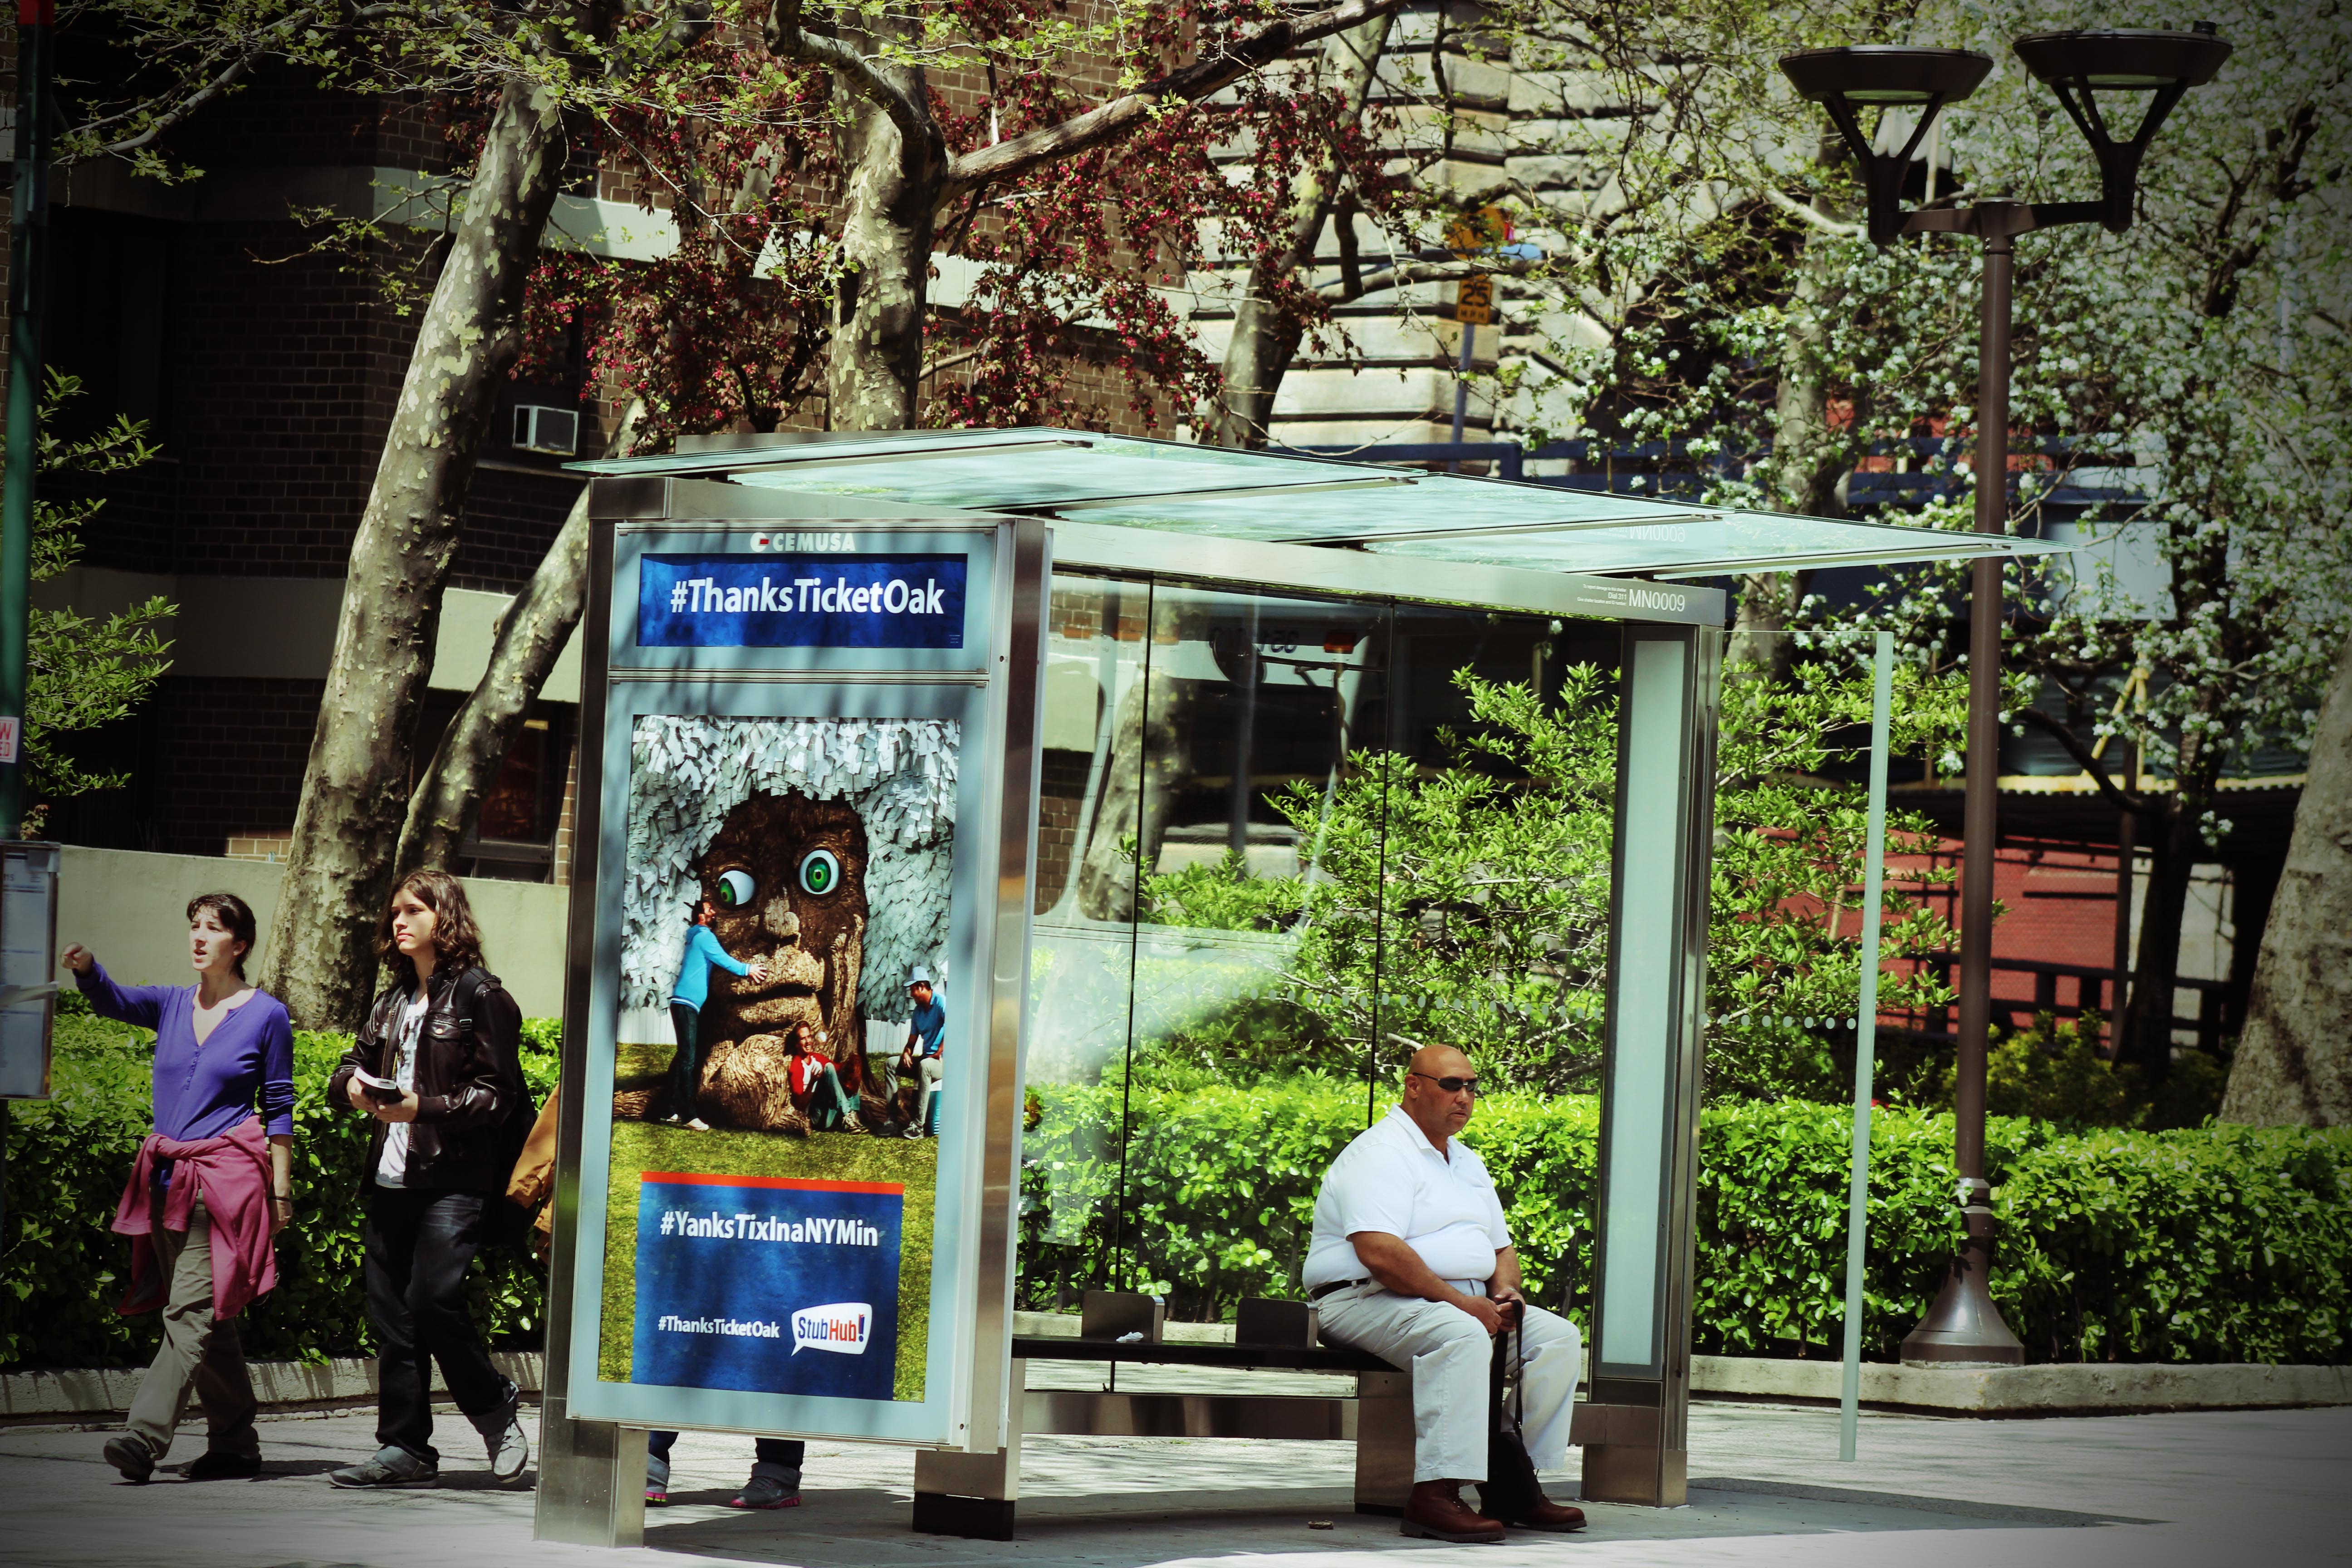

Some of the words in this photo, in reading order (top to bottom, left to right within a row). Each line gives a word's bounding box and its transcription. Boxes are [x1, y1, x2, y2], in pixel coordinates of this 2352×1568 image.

[1462, 284, 1488, 307] 25
[772, 532, 857, 552] CEMUSA
[671, 577, 945, 614] #ThanksTicketOak
[1629, 588, 1685, 612] MN0009
[660, 1210, 878, 1246] #YanksTixInaNYMin
[658, 1315, 780, 1338] #ThanksTicketOak
[798, 1313, 865, 1343] StubHub!
